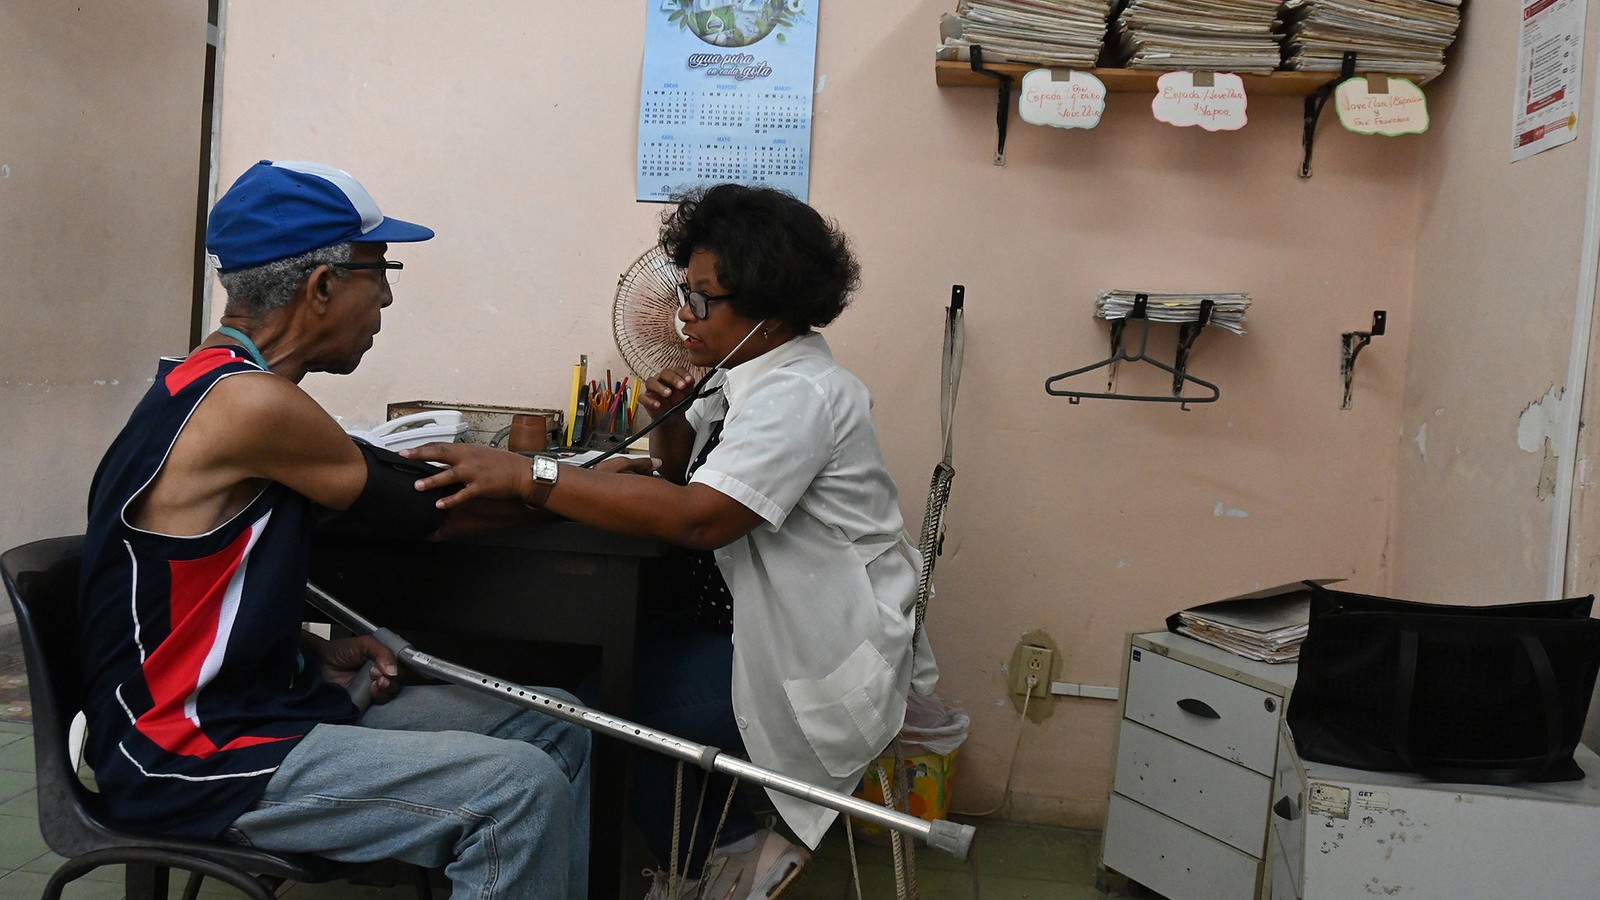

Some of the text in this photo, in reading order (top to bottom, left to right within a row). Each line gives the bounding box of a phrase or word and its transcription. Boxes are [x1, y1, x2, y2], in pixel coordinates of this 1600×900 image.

[688, 52, 755, 69] agua pura
[735, 61, 773, 81] gota
